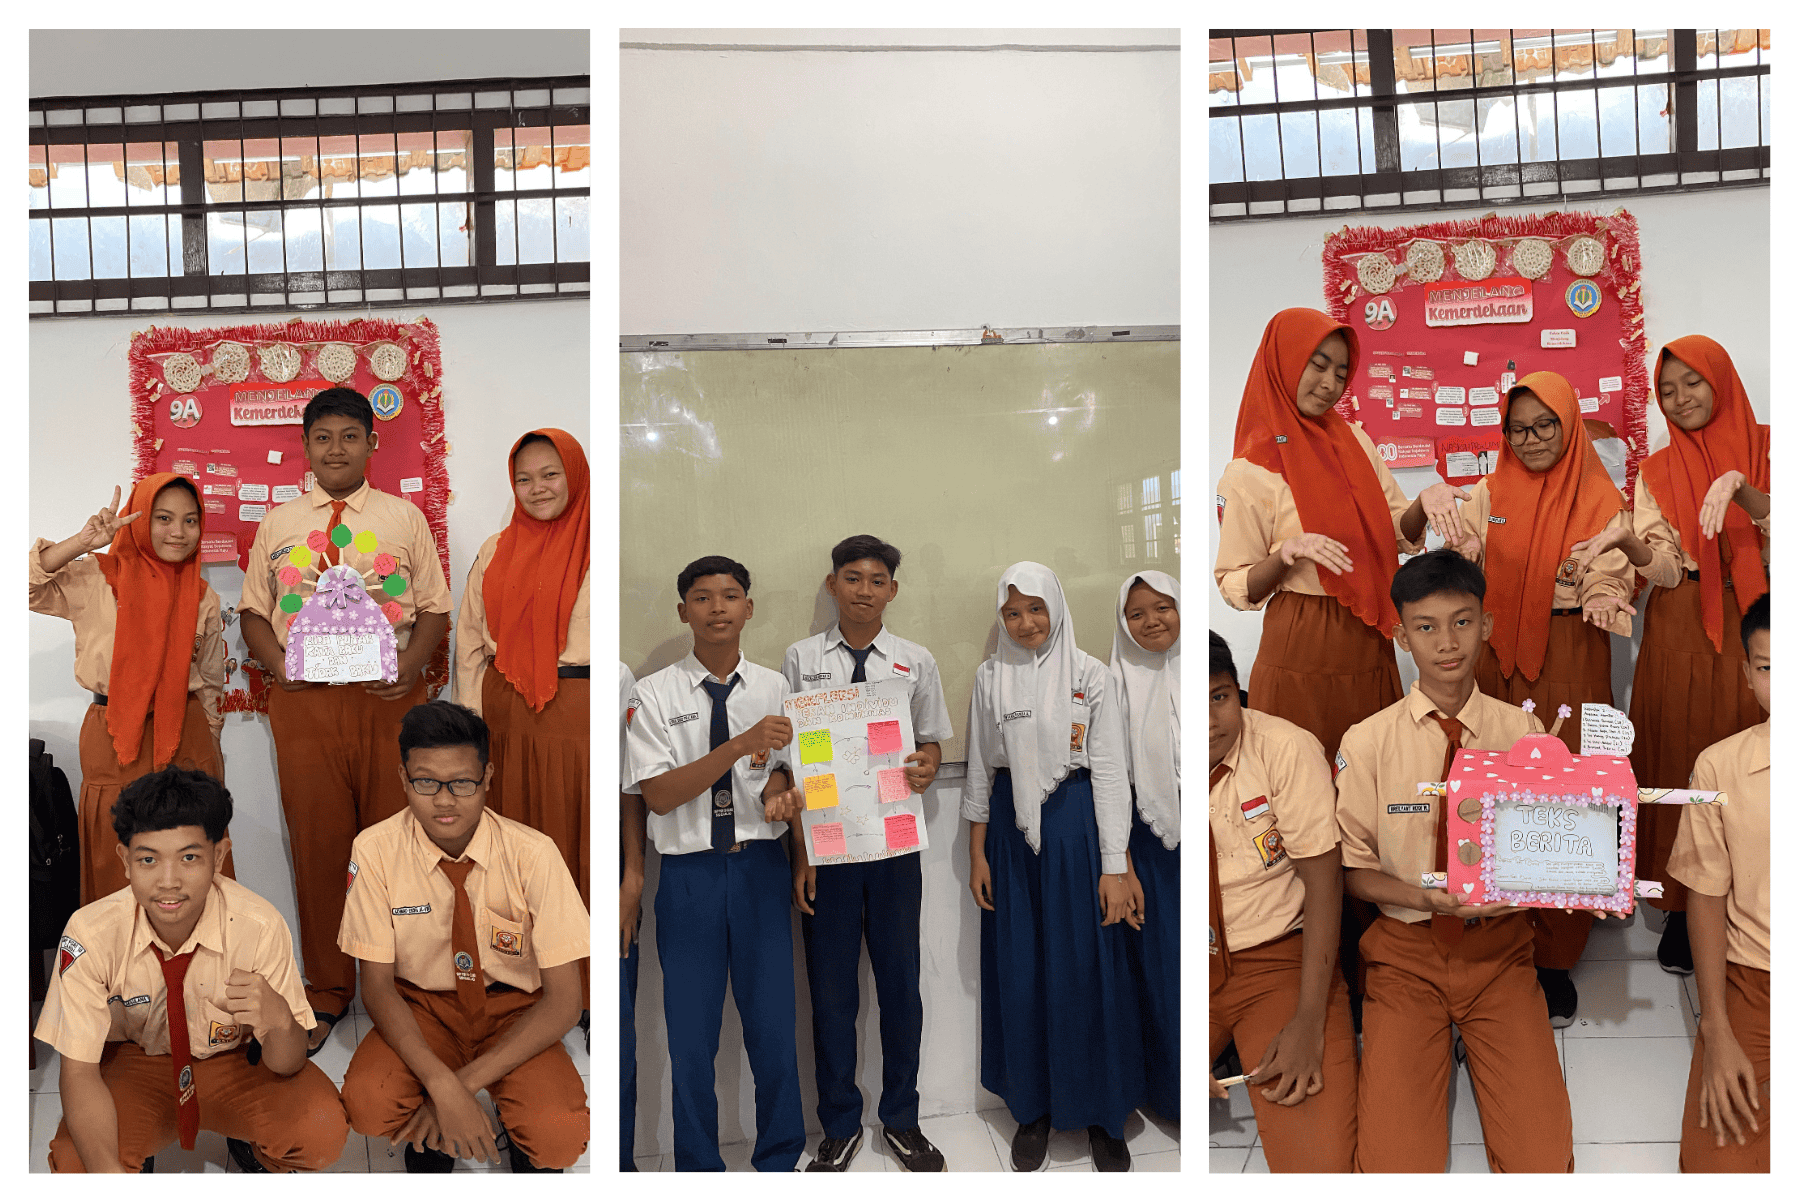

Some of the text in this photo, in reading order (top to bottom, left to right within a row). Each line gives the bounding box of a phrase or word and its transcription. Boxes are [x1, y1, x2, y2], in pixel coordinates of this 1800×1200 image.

[1428, 285, 1525, 304] MENJELANG
[1365, 300, 1395, 321] 9A
[1428, 302, 1527, 321] Kemerdekaan
[170, 399, 200, 420] 9A
[1514, 804, 1580, 831] TEKS
[1510, 830, 1593, 857] BERITA
